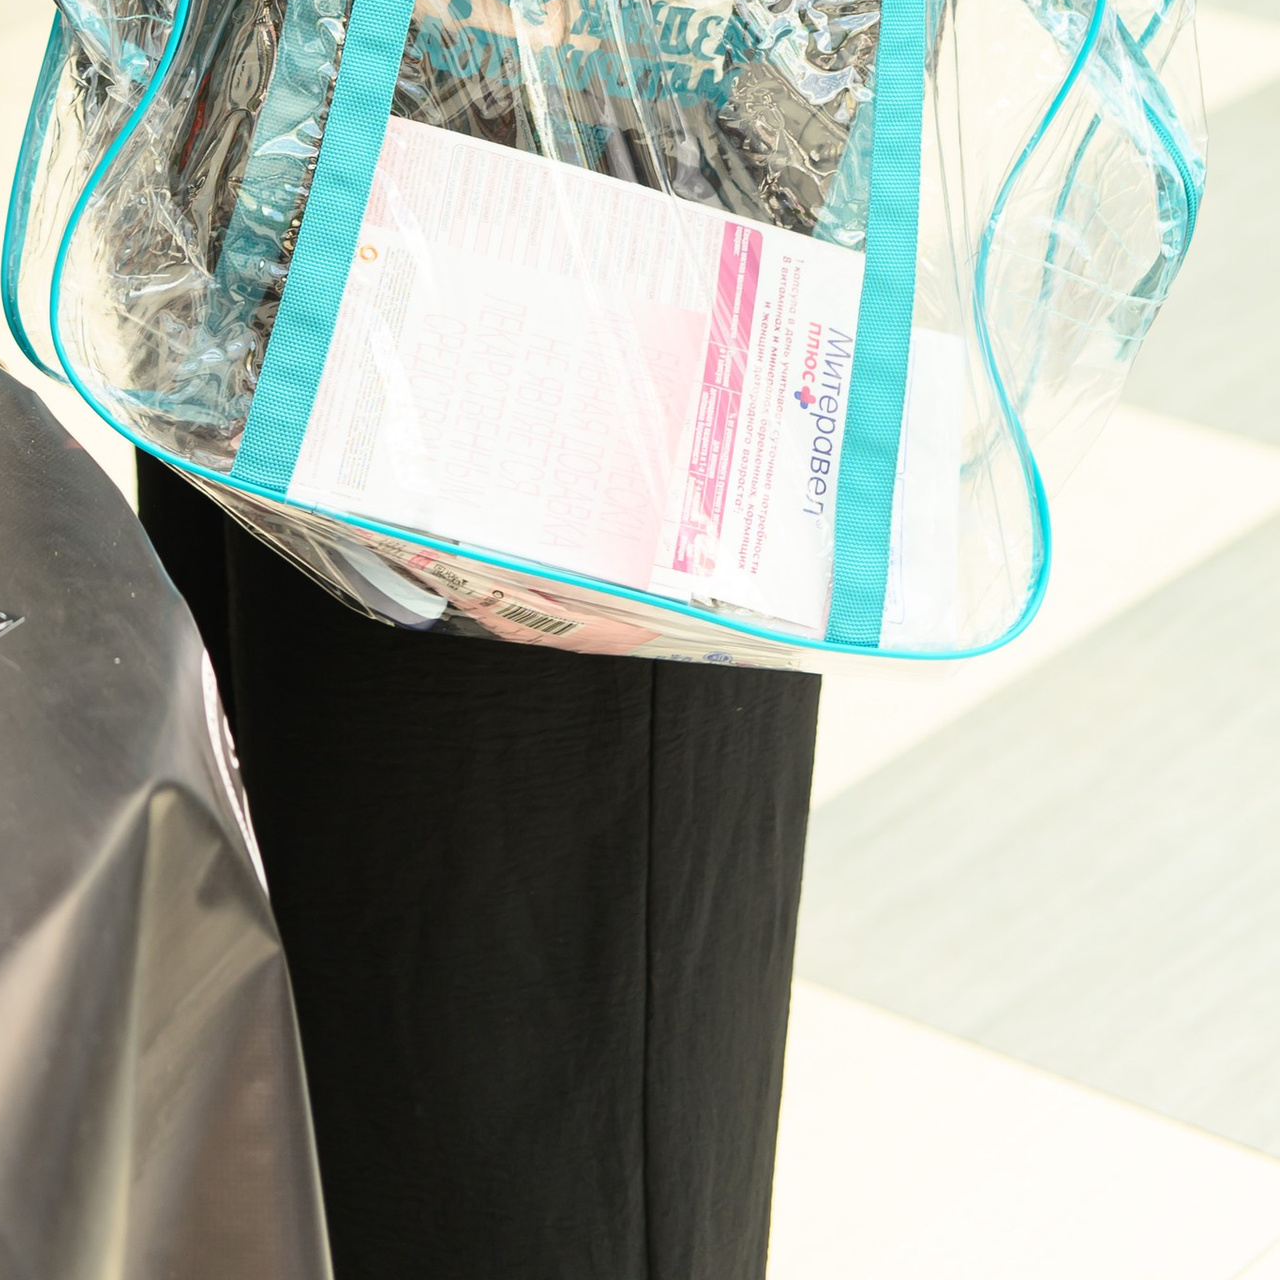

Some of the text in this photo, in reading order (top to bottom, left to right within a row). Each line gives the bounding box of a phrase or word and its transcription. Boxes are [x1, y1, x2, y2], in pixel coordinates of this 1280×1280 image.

[763, 300, 771, 309] и
[772, 266, 789, 332] витаминах
[786, 265, 802, 315] капсула
[787, 317, 794, 325] в
[754, 311, 771, 363] женщин
[771, 334, 779, 344] и
[781, 327, 795, 359] день
[802, 321, 822, 383] плюс
[436, 291, 528, 511] ЛЕКАРСТВЕННЫМ
[494, 331, 573, 498] НЕ ЯВЛЯЕТСЯ
[771, 359, 790, 426] учитывает
[797, 324, 853, 519] Митеравел
[762, 428, 781, 491] суточные
[538, 430, 606, 555] ДОБАВКА
[736, 502, 756, 570] кормящих
[749, 492, 773, 576] потребности
